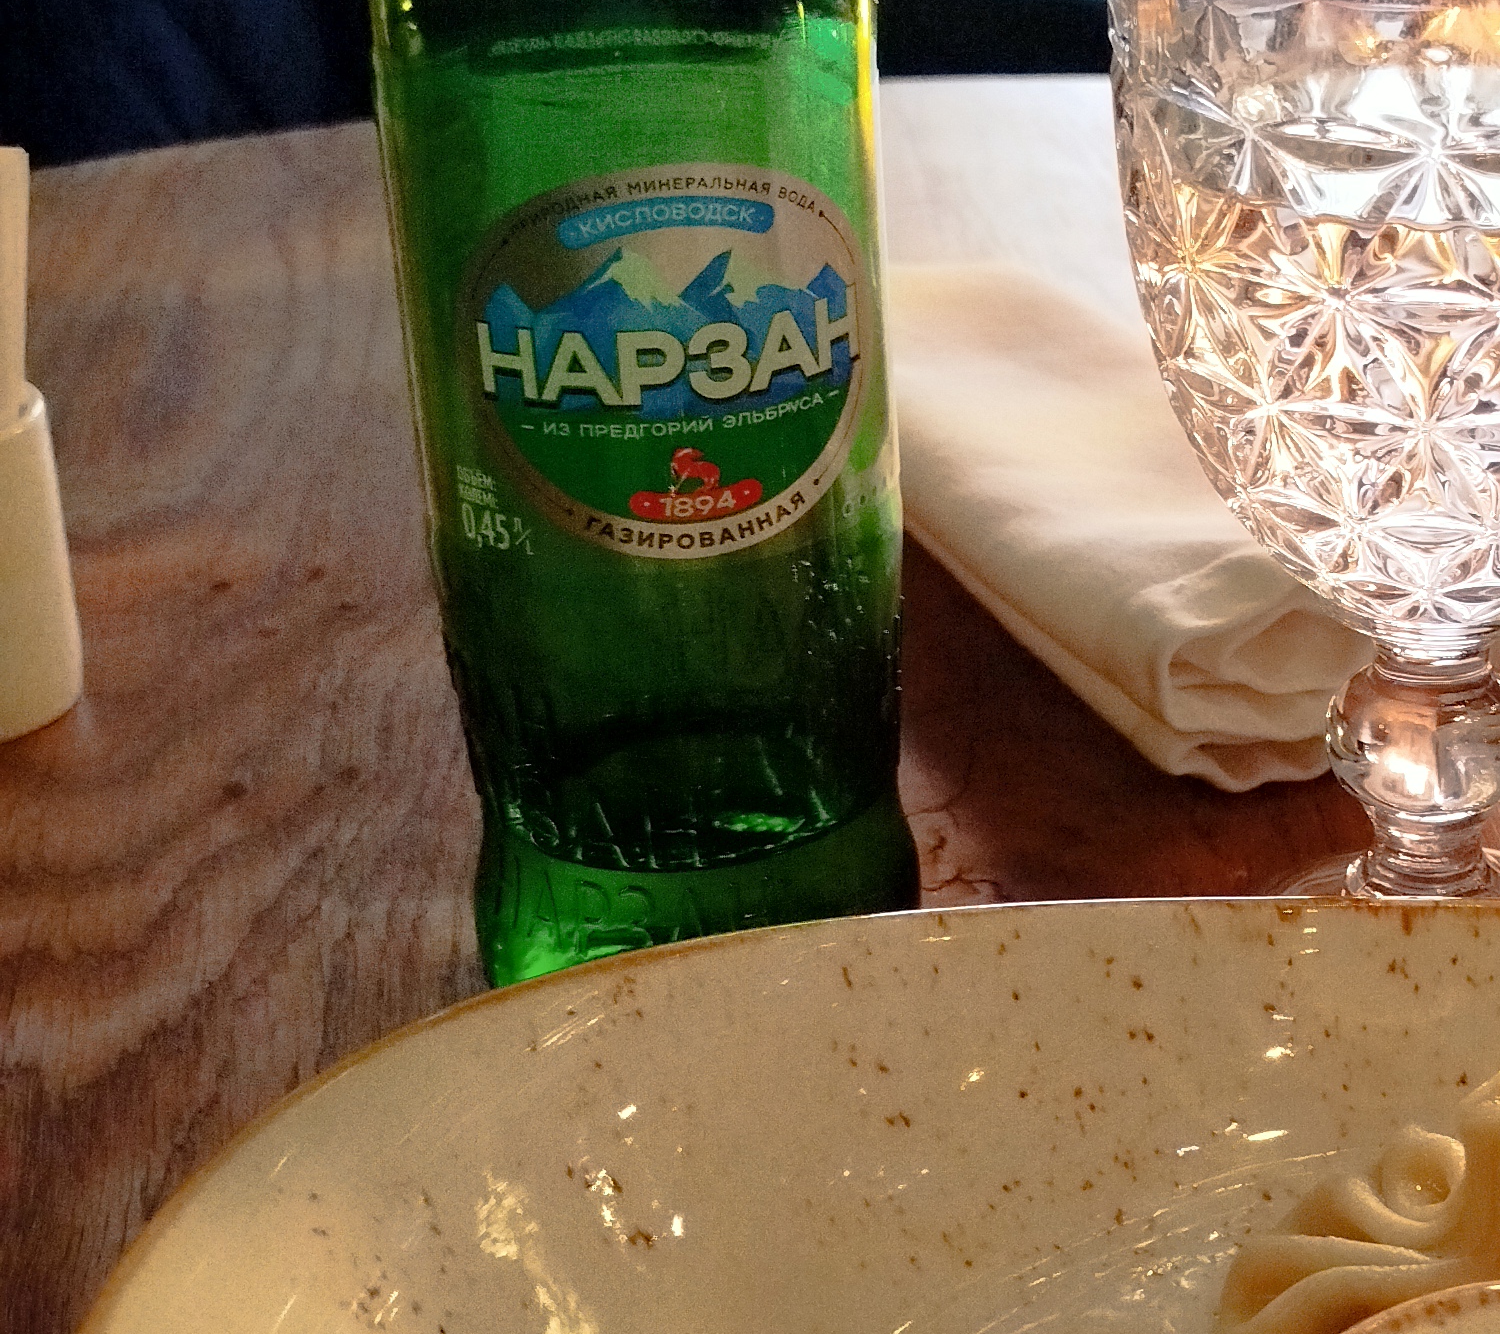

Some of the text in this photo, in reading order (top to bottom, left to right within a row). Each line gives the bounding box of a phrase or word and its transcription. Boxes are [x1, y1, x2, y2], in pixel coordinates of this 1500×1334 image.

[627, 176, 772, 197] МИНЕРАЛЬНАЯ
[777, 186, 816, 214] ВОДА
[577, 202, 756, 239] КИСЛОВОДСК
[475, 282, 858, 407] НАРЗАН
[542, 391, 825, 441] ИЗ ПРЕДГОРИЙ ЭЛЬБРУСА
[461, 503, 511, 551] 0,45
[585, 489, 807, 550] ГАЗИРОВАННАЯ
[658, 489, 737, 518] 1894
